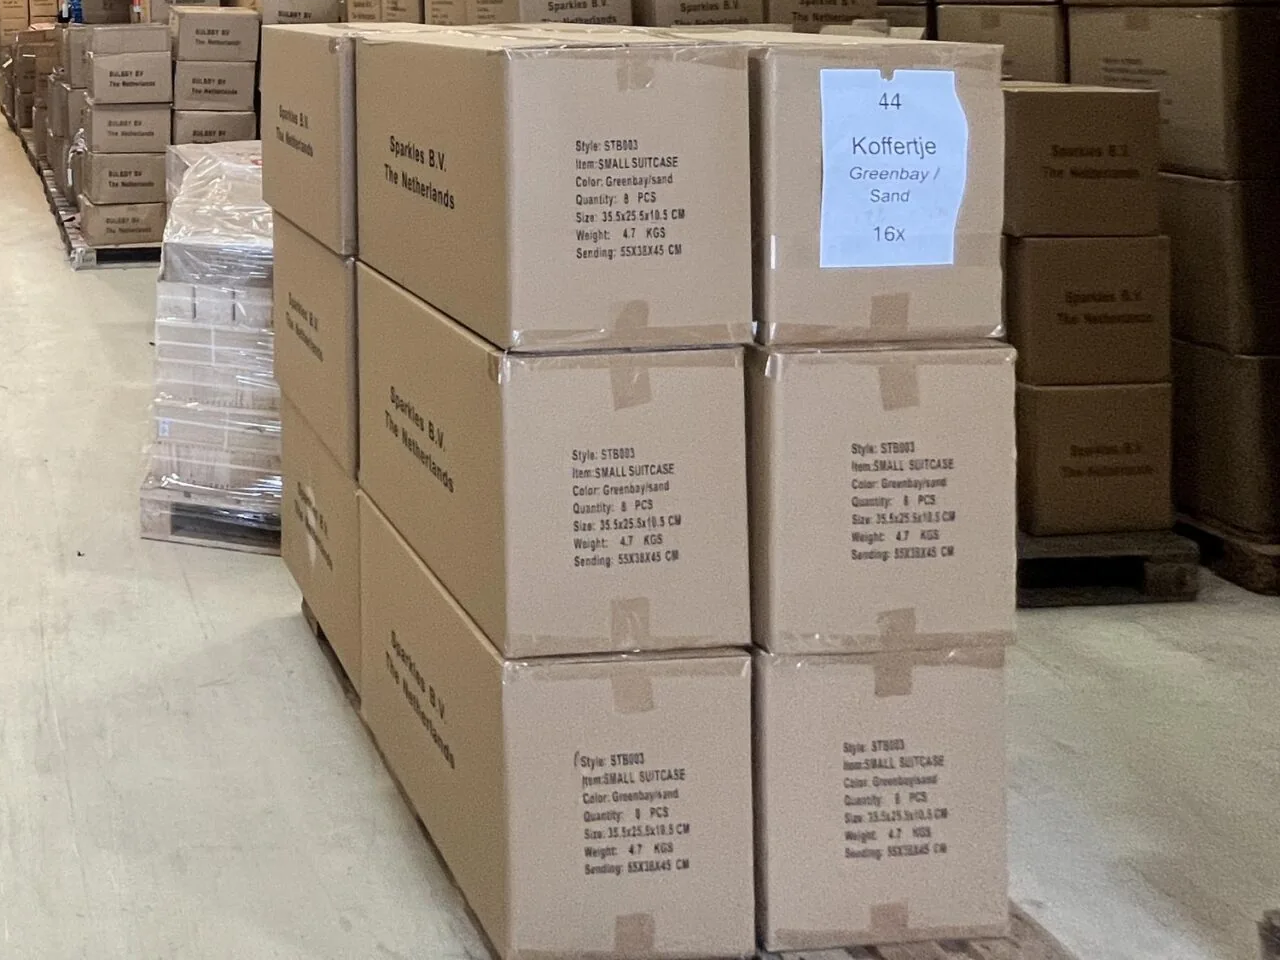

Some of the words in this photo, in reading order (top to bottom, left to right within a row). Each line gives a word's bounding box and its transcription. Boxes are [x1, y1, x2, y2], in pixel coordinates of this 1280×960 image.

[879, 92, 901, 110] 44
[390, 136, 424, 164] Sparkles
[429, 148, 447, 172] B.V.
[576, 140, 601, 154] Style:
[604, 139, 638, 151] STB003
[852, 136, 936, 159] Koffertje
[632, 156, 678, 168] SUITCASE
[576, 176, 603, 187] Color:
[849, 167, 929, 183] Greenbay
[384, 163, 398, 184] The
[402, 171, 455, 209] Netherlands
[576, 194, 617, 206] Quantity:
[638, 192, 657, 203] PCS
[870, 189, 910, 203] Sand
[576, 212, 597, 223] Size:
[671, 209, 685, 219] CM
[576, 229, 610, 243] Weight:
[623, 228, 636, 238] 4.7
[646, 227, 666, 238] KGS
[873, 226, 905, 242] 16x
[576, 247, 616, 260] Sending:
[668, 244, 682, 255] CM
[391, 386, 424, 432] Sparkles
[385, 409, 398, 437] The
[402, 428, 454, 493] Netherlands
[572, 449, 598, 463] Style:
[601, 447, 635, 460] STB003
[629, 463, 675, 476] SUITCASE
[573, 485, 600, 496] Color:
[573, 502, 614, 515] Quantity:
[635, 499, 653, 510] PCS
[573, 520, 596, 532] Size:
[668, 514, 681, 526] CM
[574, 538, 608, 552] Weight:
[644, 533, 663, 545] KGS
[574, 555, 613, 568] Sending:
[665, 549, 679, 561] CM
[581, 756, 606, 770] Style:
[640, 768, 686, 782] SUITCASE
[583, 793, 610, 804] Color:
[584, 811, 622, 823] Quantity:
[650, 806, 669, 818] PCS
[584, 828, 605, 839] Size:
[676, 823, 690, 835] CM
[585, 846, 618, 859] Weight:
[585, 863, 622, 876] Sending:
[676, 859, 690, 870] CM
